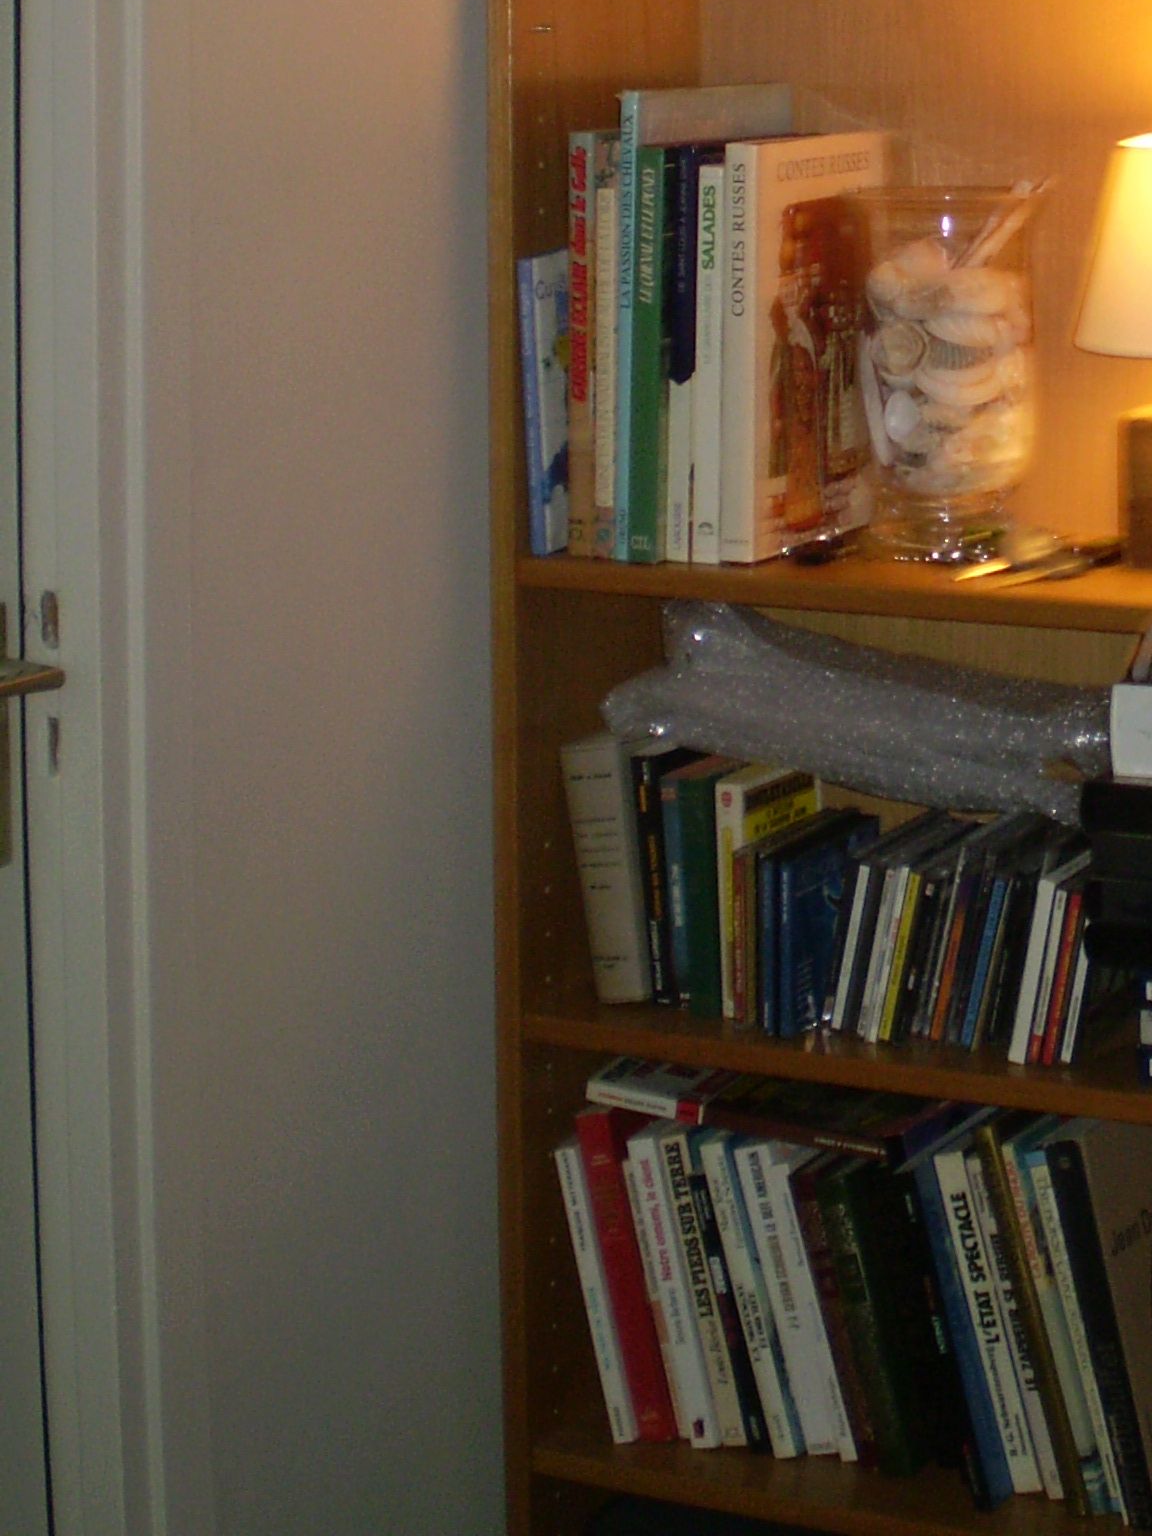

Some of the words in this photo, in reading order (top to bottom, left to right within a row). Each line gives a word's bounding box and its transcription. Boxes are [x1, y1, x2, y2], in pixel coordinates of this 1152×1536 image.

[619, 114, 634, 186] CHEVAUX
[776, 157, 826, 183] CONTES
[826, 149, 871, 172] RUSSES
[621, 191, 632, 218] DES
[731, 162, 746, 232] RUSSES
[571, 216, 586, 256] dans
[702, 184, 715, 269] SALADES
[619, 224, 632, 284] PASSION
[730, 238, 745, 318] CONTES
[619, 290, 630, 308] LA
[663, 1141, 689, 1199] TERRE
[675, 1201, 697, 1236] SUR
[948, 1190, 987, 1284] SPECTACLE
[655, 1247, 673, 1282] Notre
[683, 1236, 708, 1286] PIEDS
[694, 1286, 715, 1319] LES
